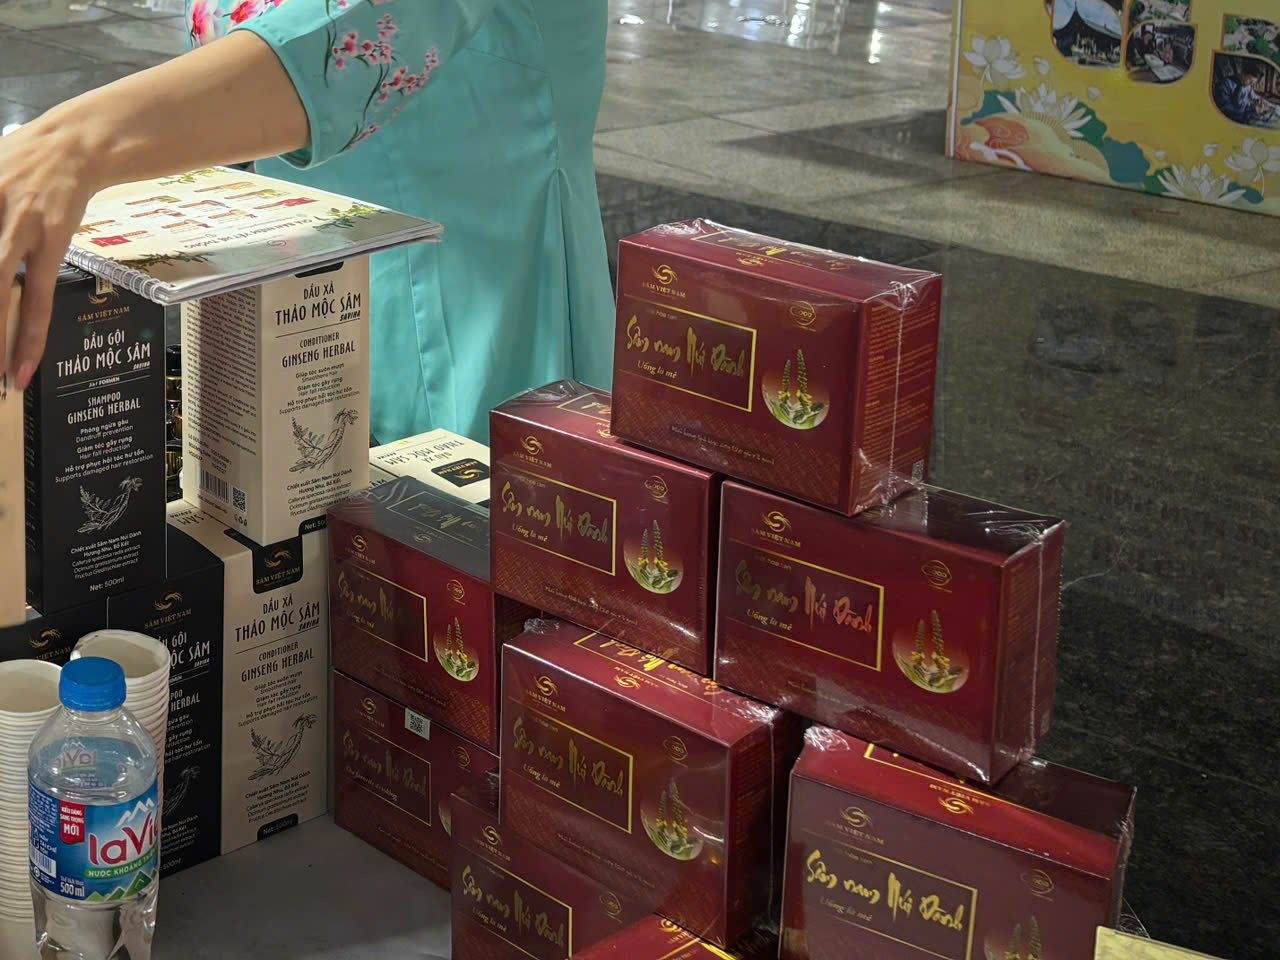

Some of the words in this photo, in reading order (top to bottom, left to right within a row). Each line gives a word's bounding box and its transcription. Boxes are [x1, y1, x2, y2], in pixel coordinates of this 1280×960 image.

[323, 281, 335, 296] XẢ
[275, 303, 307, 326] THẢO
[312, 297, 335, 319] MỘC
[340, 292, 361, 313] SÂM
[83, 331, 104, 351] DẦU
[108, 328, 125, 347] GỘI
[300, 331, 340, 349] CONDITIONER
[56, 354, 90, 378] THẢO
[96, 347, 122, 370] MỘC
[126, 340, 151, 363] SÂM
[282, 348, 320, 368] GINSENG
[323, 340, 356, 359] HERBAL
[67, 406, 104, 425] GINSENG
[107, 397, 141, 416] HERBAL
[87, 391, 121, 408] SHAMPOO
[63, 823, 80, 836] MỚI
